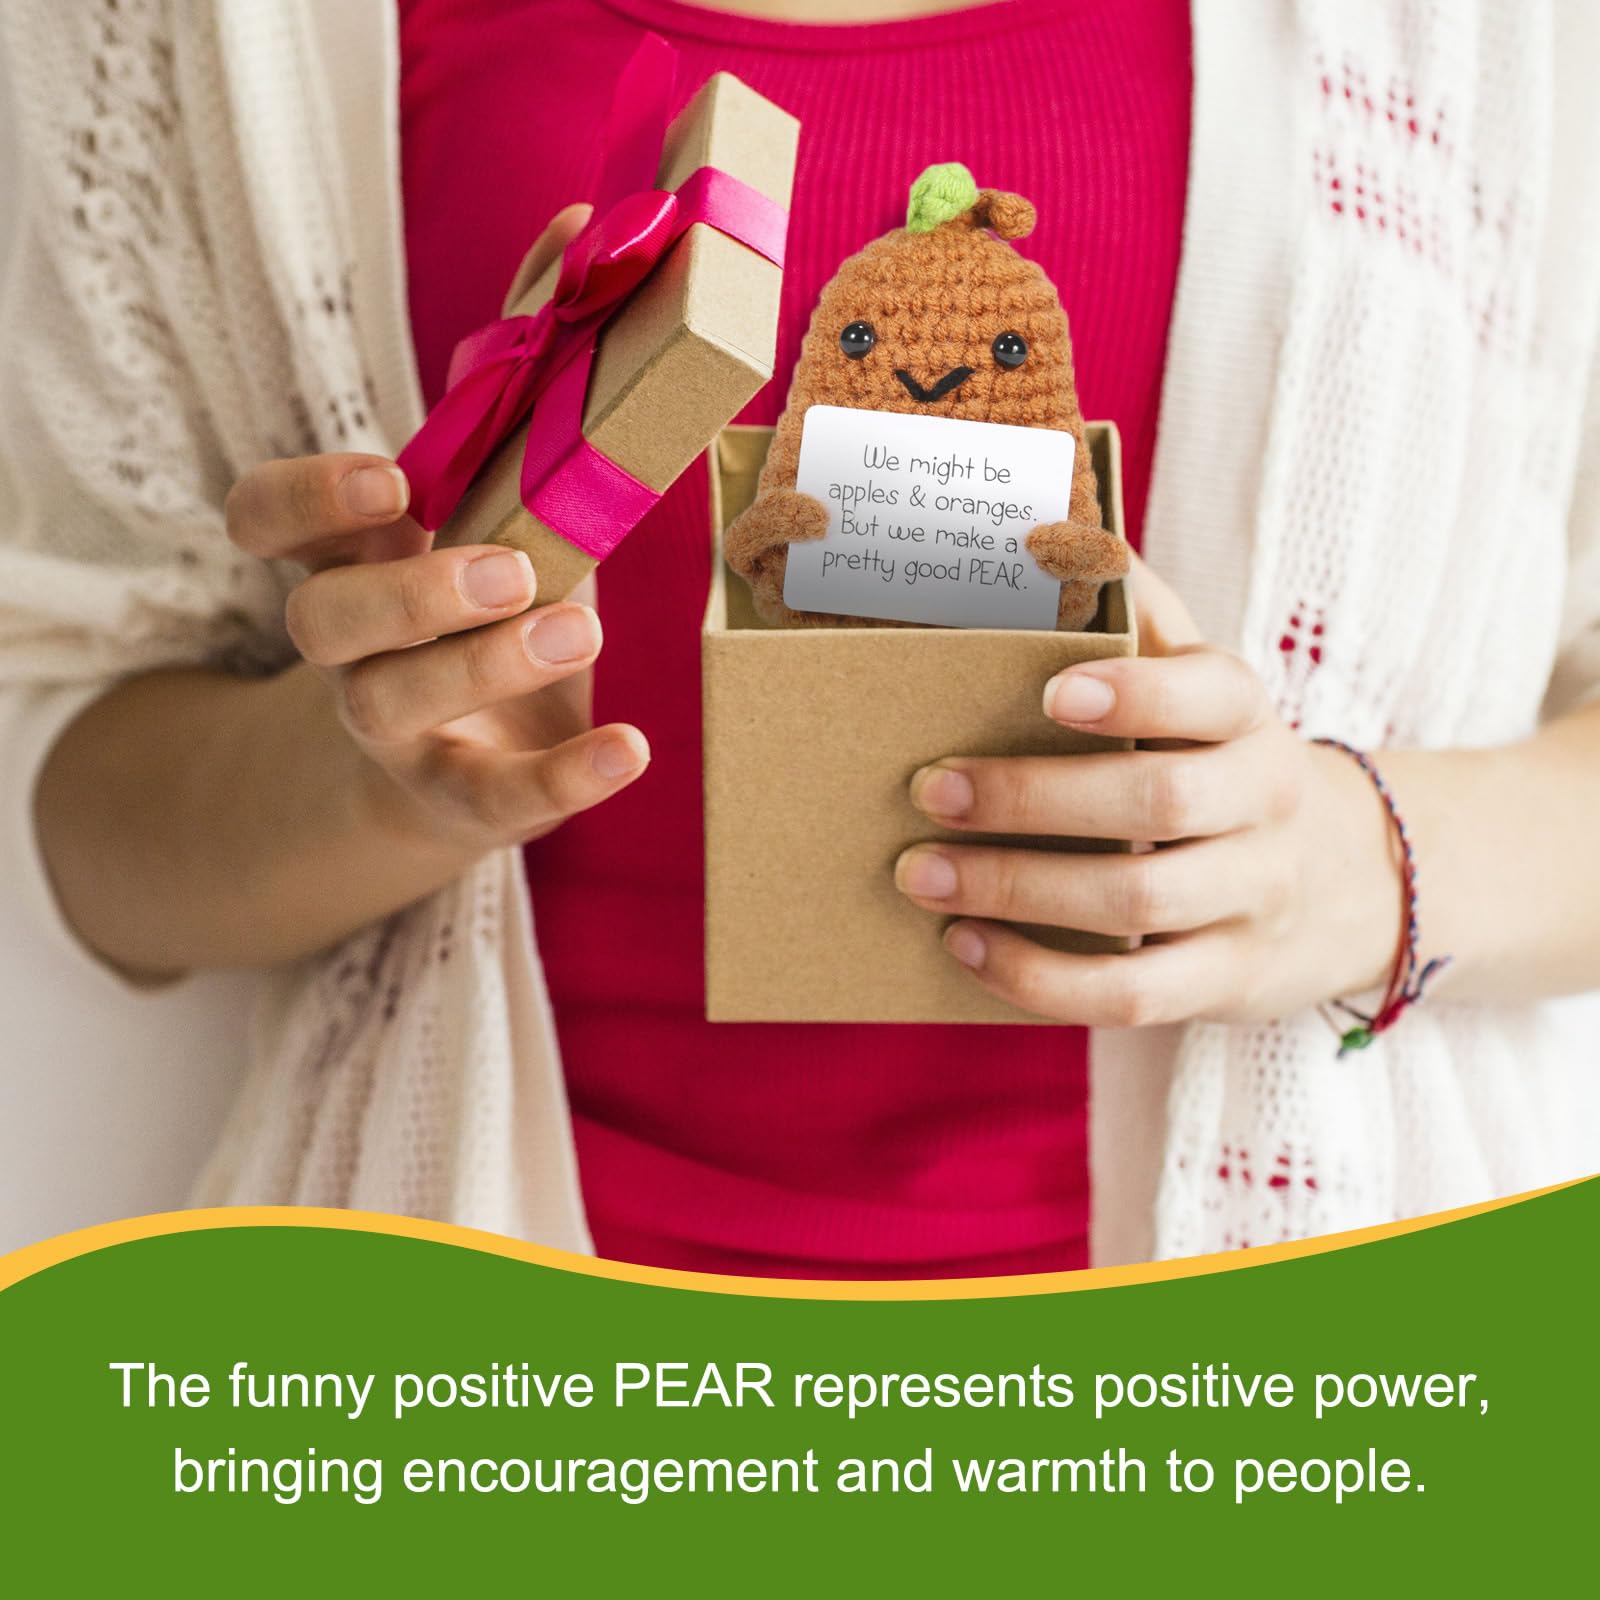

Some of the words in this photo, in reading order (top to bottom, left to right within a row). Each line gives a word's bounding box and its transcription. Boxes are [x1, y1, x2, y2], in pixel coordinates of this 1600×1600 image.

[863, 444, 900, 469] We
[910, 453, 975, 485] might
[984, 457, 1011, 484] be
[829, 480, 900, 511] apples
[909, 484, 926, 509] &
[935, 495, 1037, 526] oranges.
[841, 510, 880, 536] But
[888, 524, 926, 543] we
[935, 526, 996, 551] make
[1004, 537, 1018, 554] a
[822, 549, 895, 582] pretty
[904, 558, 961, 585] good
[969, 559, 1028, 591] PEAR.
